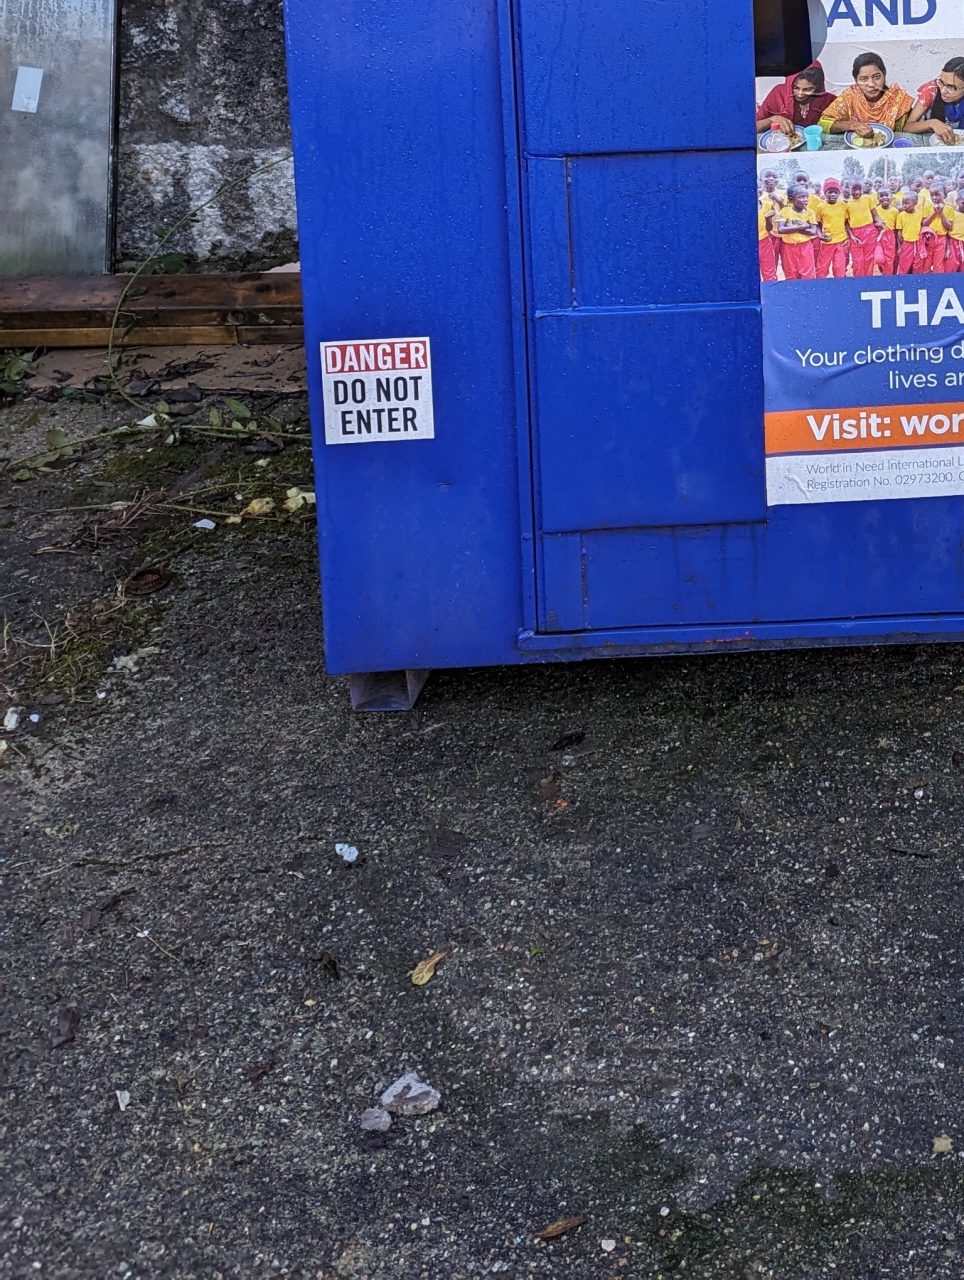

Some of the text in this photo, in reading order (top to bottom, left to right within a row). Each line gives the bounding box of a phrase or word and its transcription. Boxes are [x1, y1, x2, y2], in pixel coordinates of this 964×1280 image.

[326, 343, 427, 373] DANGER
[796, 348, 847, 367] Your
[854, 344, 944, 364] clothing
[334, 376, 422, 405] DO NOT
[889, 371, 937, 389] lives
[341, 407, 418, 435] ENTER
[807, 412, 890, 441] Visit:
[806, 463, 839, 475] World
[842, 463, 852, 473] in
[855, 462, 884, 473] Need
[888, 456, 954, 470] International
[807, 477, 870, 491] Registration
[873, 477, 892, 487] No.
[895, 473, 955, 485] 02973200.
